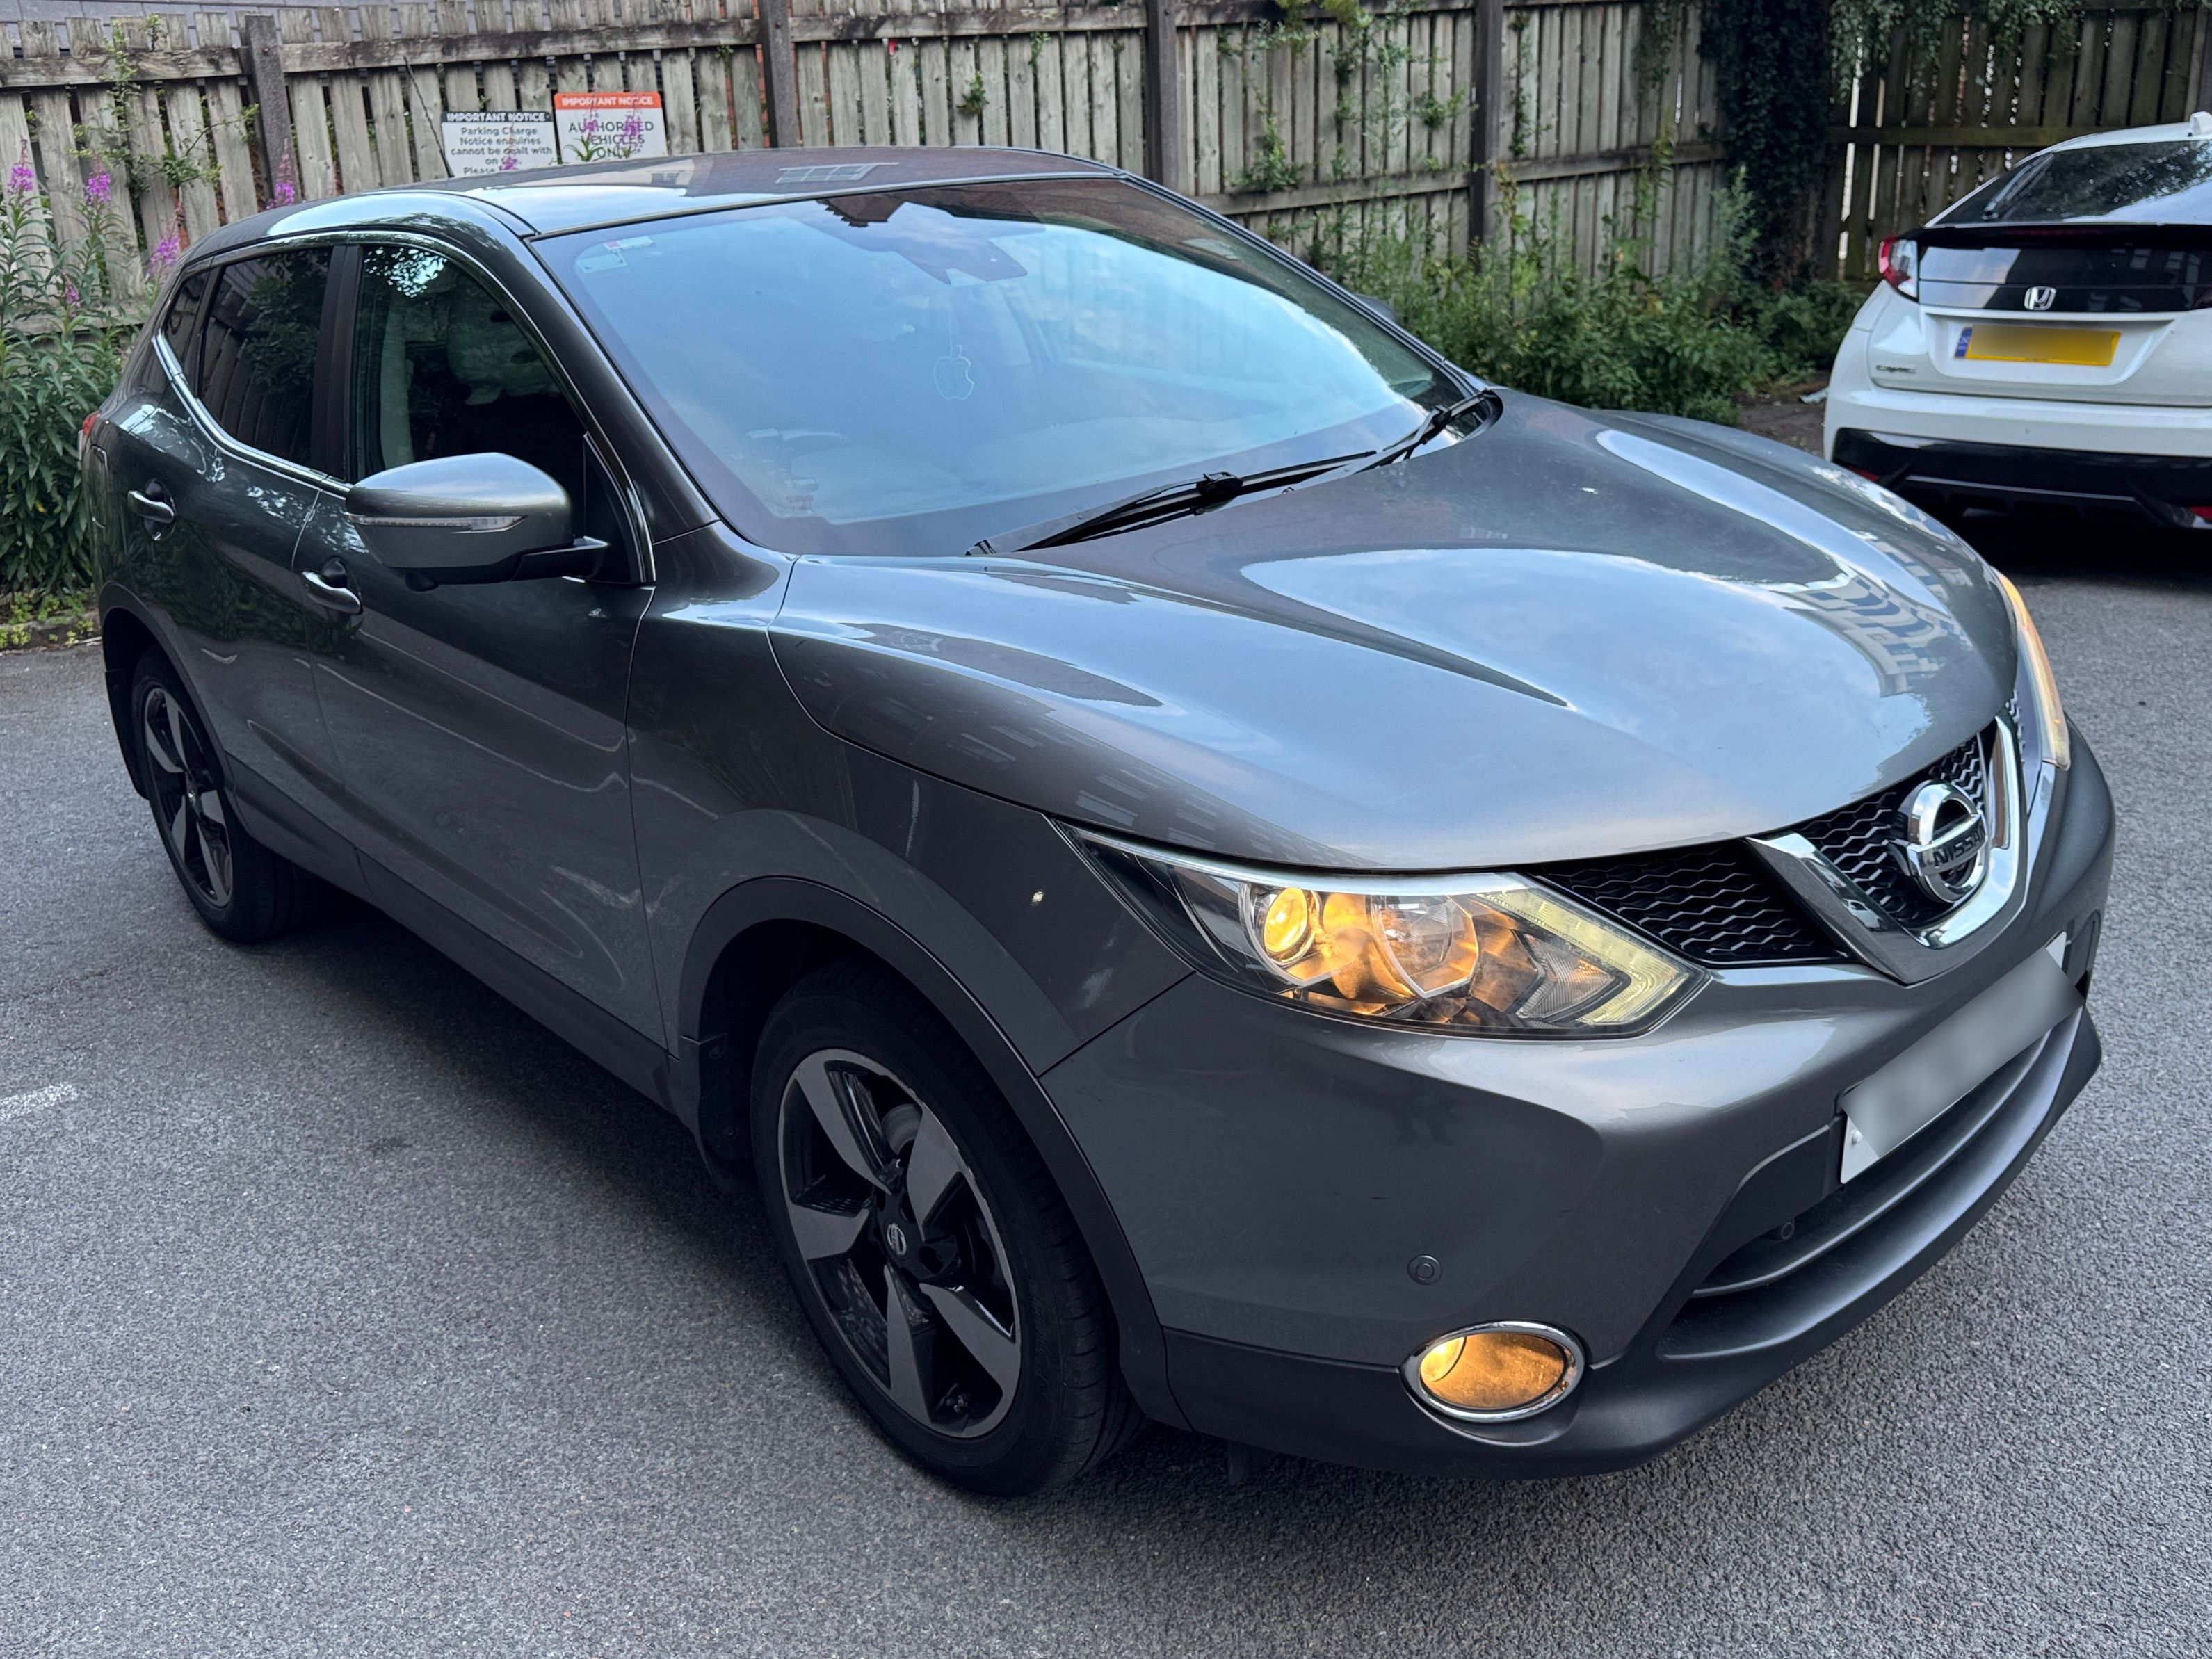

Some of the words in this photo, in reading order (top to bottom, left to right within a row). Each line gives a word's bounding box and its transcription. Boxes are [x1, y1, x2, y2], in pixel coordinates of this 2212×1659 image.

[561, 96, 617, 106] IMPORTANT
[446, 112, 506, 122] IMPORTANT
[508, 112, 546, 122] NOTICE
[461, 127, 499, 136] Parking
[568, 121, 654, 133] AUHORED
[460, 137, 494, 145] Notice
[580, 134, 645, 145] EHICLES
[451, 147, 485, 155] cannot
[488, 146, 501, 155] be
[531, 146, 553, 155] with
